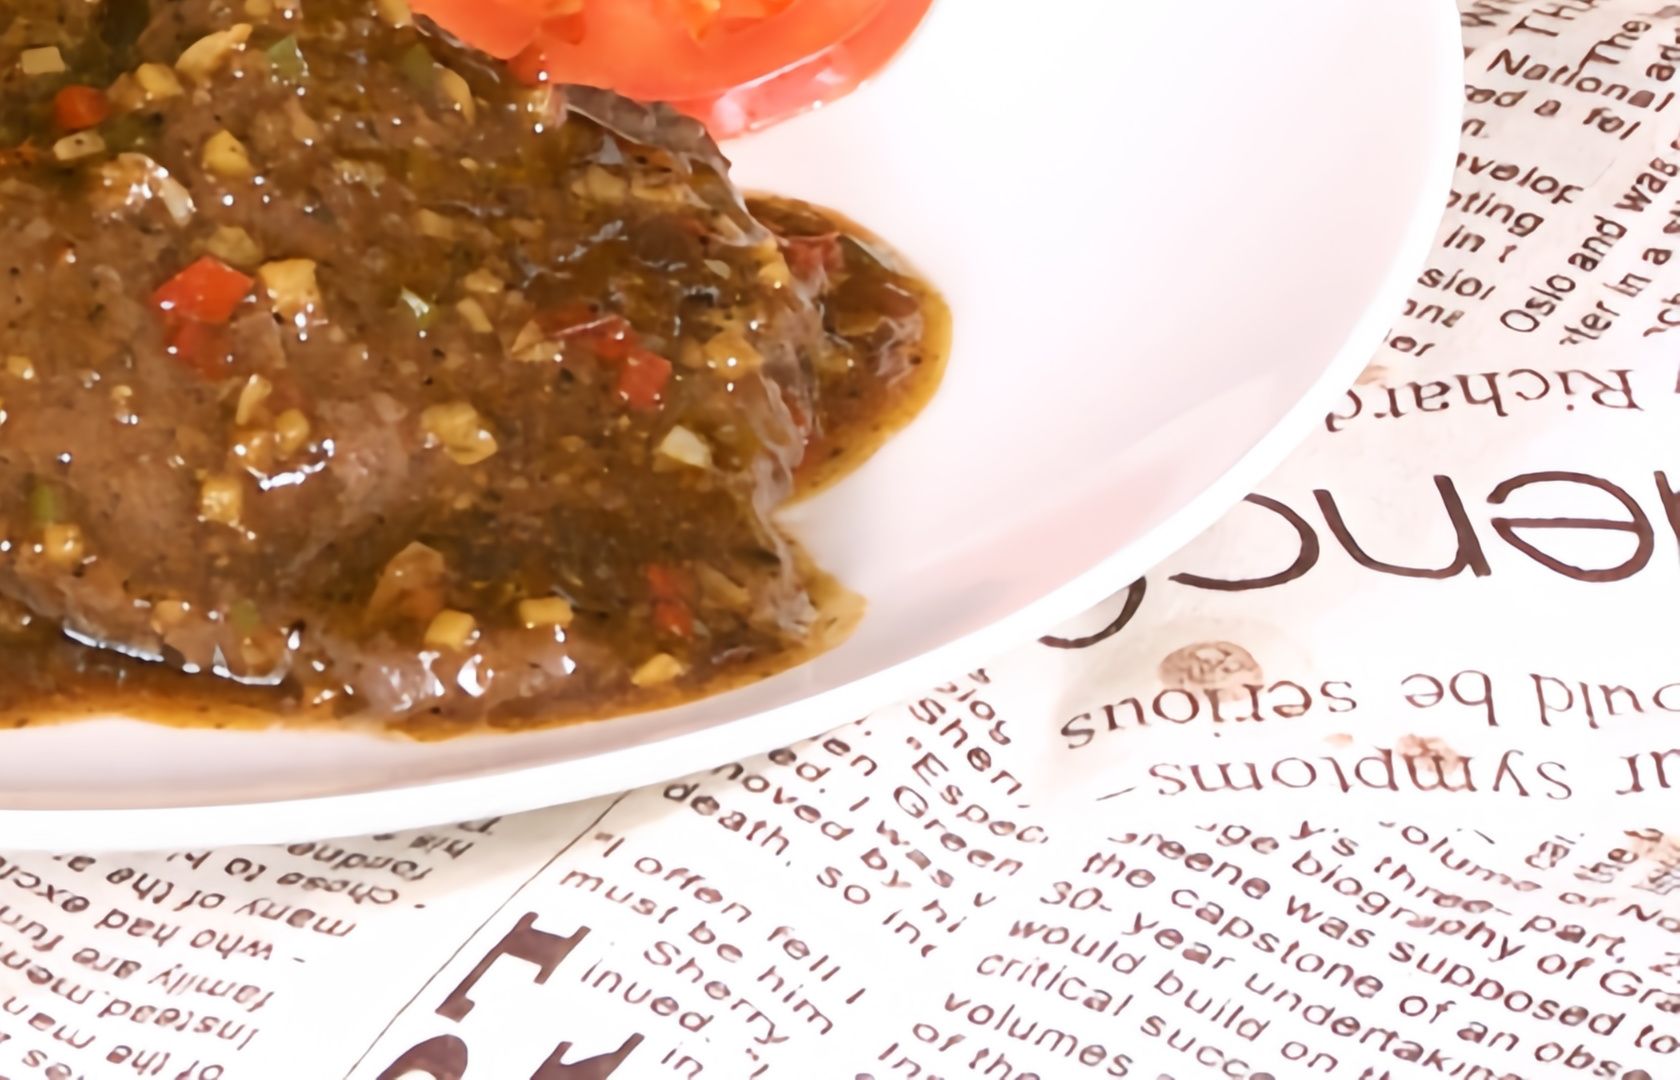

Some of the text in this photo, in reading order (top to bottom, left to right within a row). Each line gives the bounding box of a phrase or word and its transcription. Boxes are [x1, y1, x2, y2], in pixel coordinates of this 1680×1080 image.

[1499, 274, 1577, 333] Oslo
[1567, 214, 1628, 273] and
[1060, 680, 1358, 750] serious
[1401, 669, 1499, 727] be
[1148, 735, 1573, 800] symptoms
[93, 908, 181, 948] had
[687, 920, 744, 961] be
[756, 965, 834, 1036] him
[1170, 889, 1384, 999] capstone
[1398, 995, 1457, 1024] of
[1456, 1021, 1520, 1052] an
[1286, 894, 1376, 948] was
[1388, 941, 1627, 1037] supposed
[2, 996, 96, 1050] man
[1153, 969, 1271, 1042] build
[1280, 1041, 1339, 1073] on
